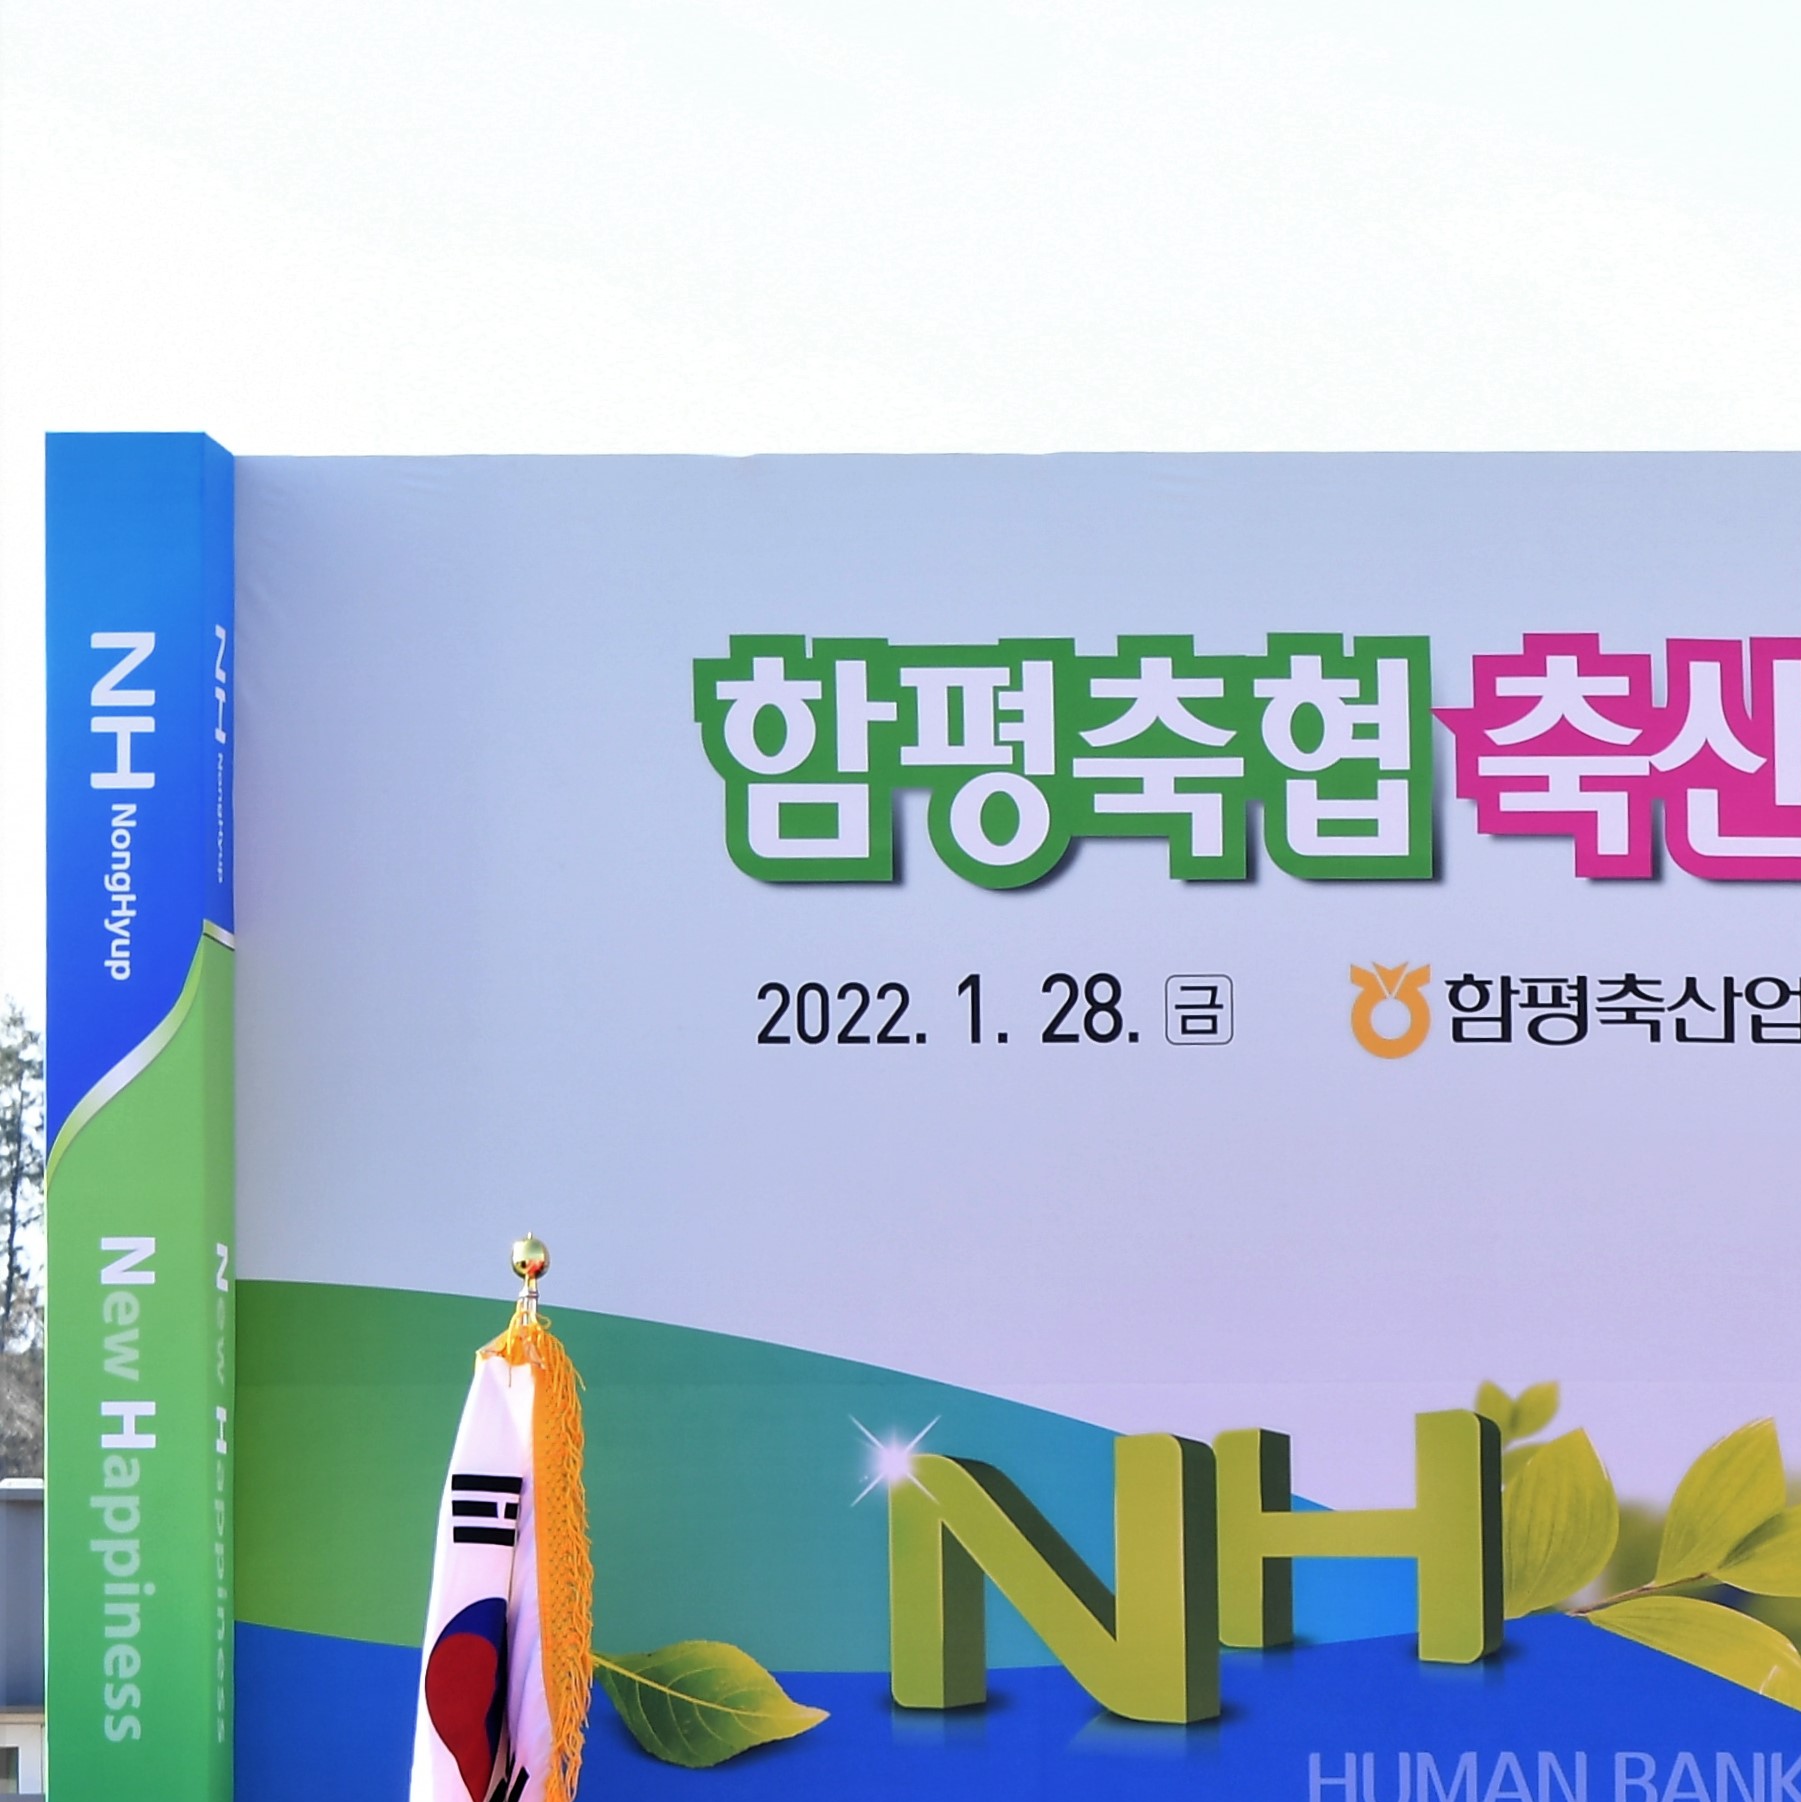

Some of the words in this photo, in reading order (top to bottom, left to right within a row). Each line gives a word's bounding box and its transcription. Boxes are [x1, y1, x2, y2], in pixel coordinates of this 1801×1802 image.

[90, 632, 155, 789] NH
[714, 653, 1414, 868] 함평축협
[104, 804, 137, 981] NongHyup
[756, 982, 928, 1046] 2022.
[957, 973, 1009, 1045] 1.
[1040, 972, 1140, 1044] 28.
[1170, 980, 1229, 1041] 금
[100, 1237, 156, 1382] New
[90, 1401, 156, 1742] Happiness
[888, 1408, 1502, 1724] NH
